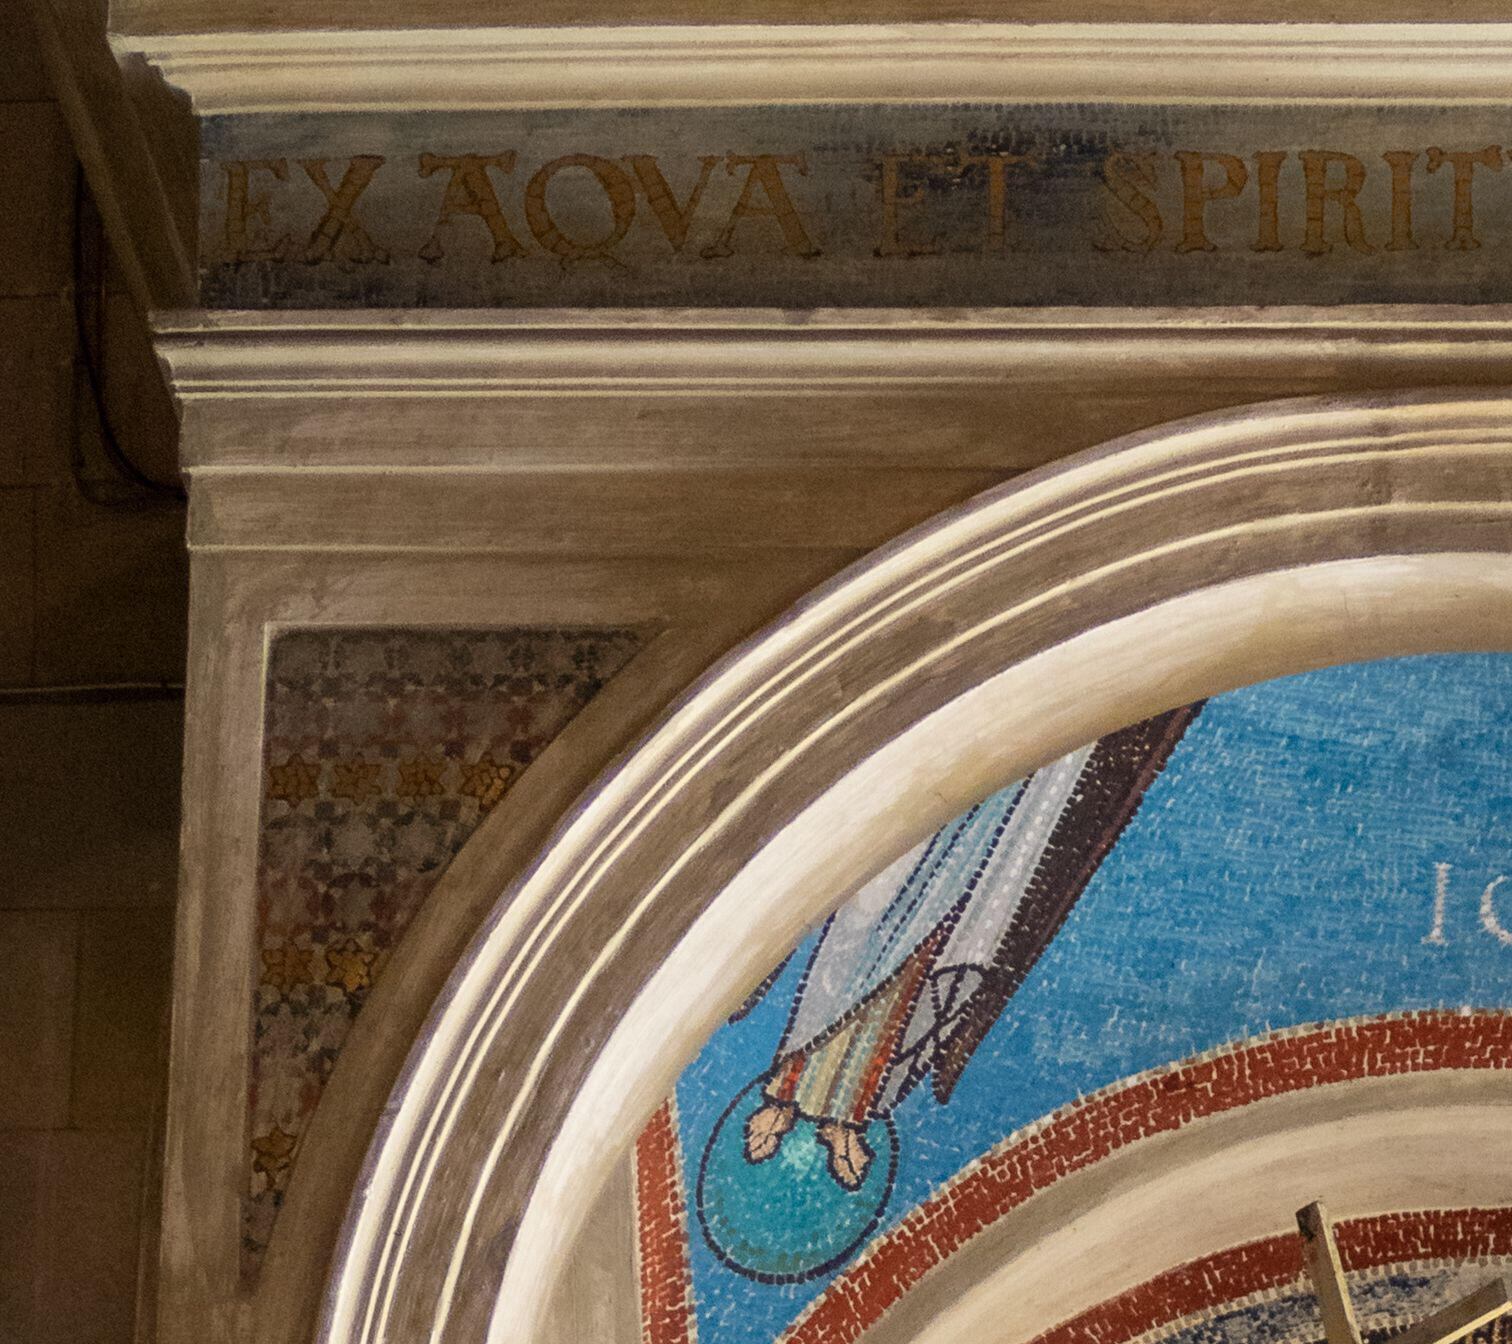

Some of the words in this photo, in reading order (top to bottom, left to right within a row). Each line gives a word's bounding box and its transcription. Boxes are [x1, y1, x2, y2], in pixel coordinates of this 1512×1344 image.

[218, 153, 391, 267] EX
[417, 150, 824, 276] AQVA
[872, 149, 1030, 258] ET
